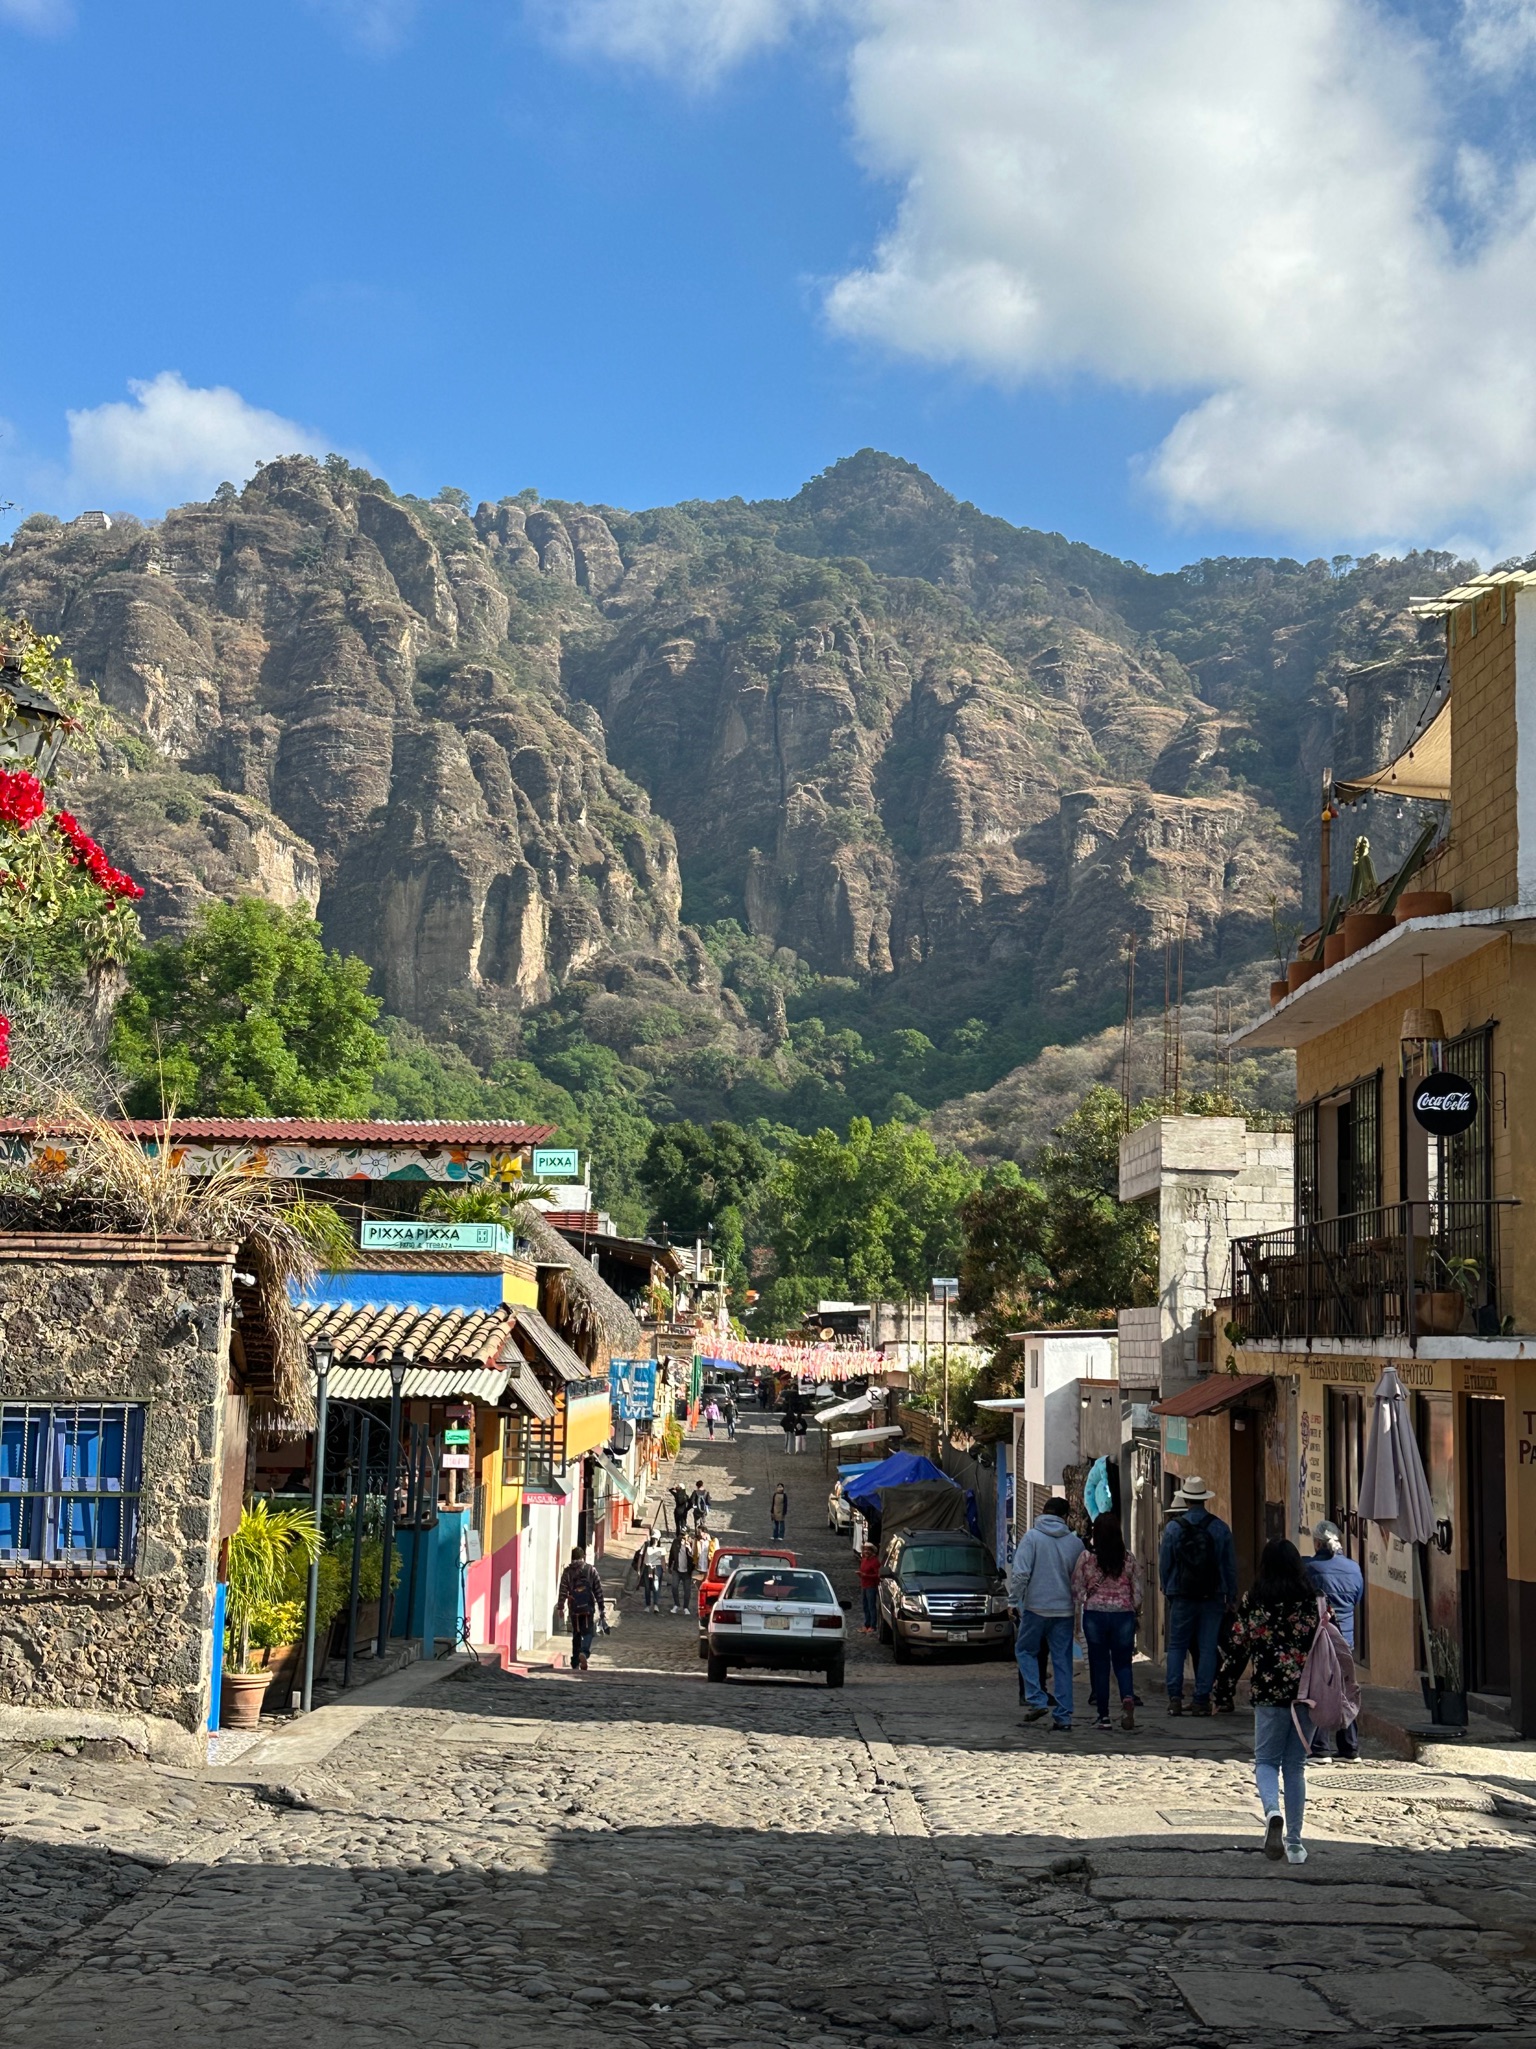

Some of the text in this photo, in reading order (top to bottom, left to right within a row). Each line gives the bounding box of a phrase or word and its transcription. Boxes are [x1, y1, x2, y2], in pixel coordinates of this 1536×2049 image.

[1416, 1092, 1472, 1111] Coca-Cola
[539, 1157, 572, 1167] PIXXA
[370, 1227, 460, 1240] PIXXA PIXXA
